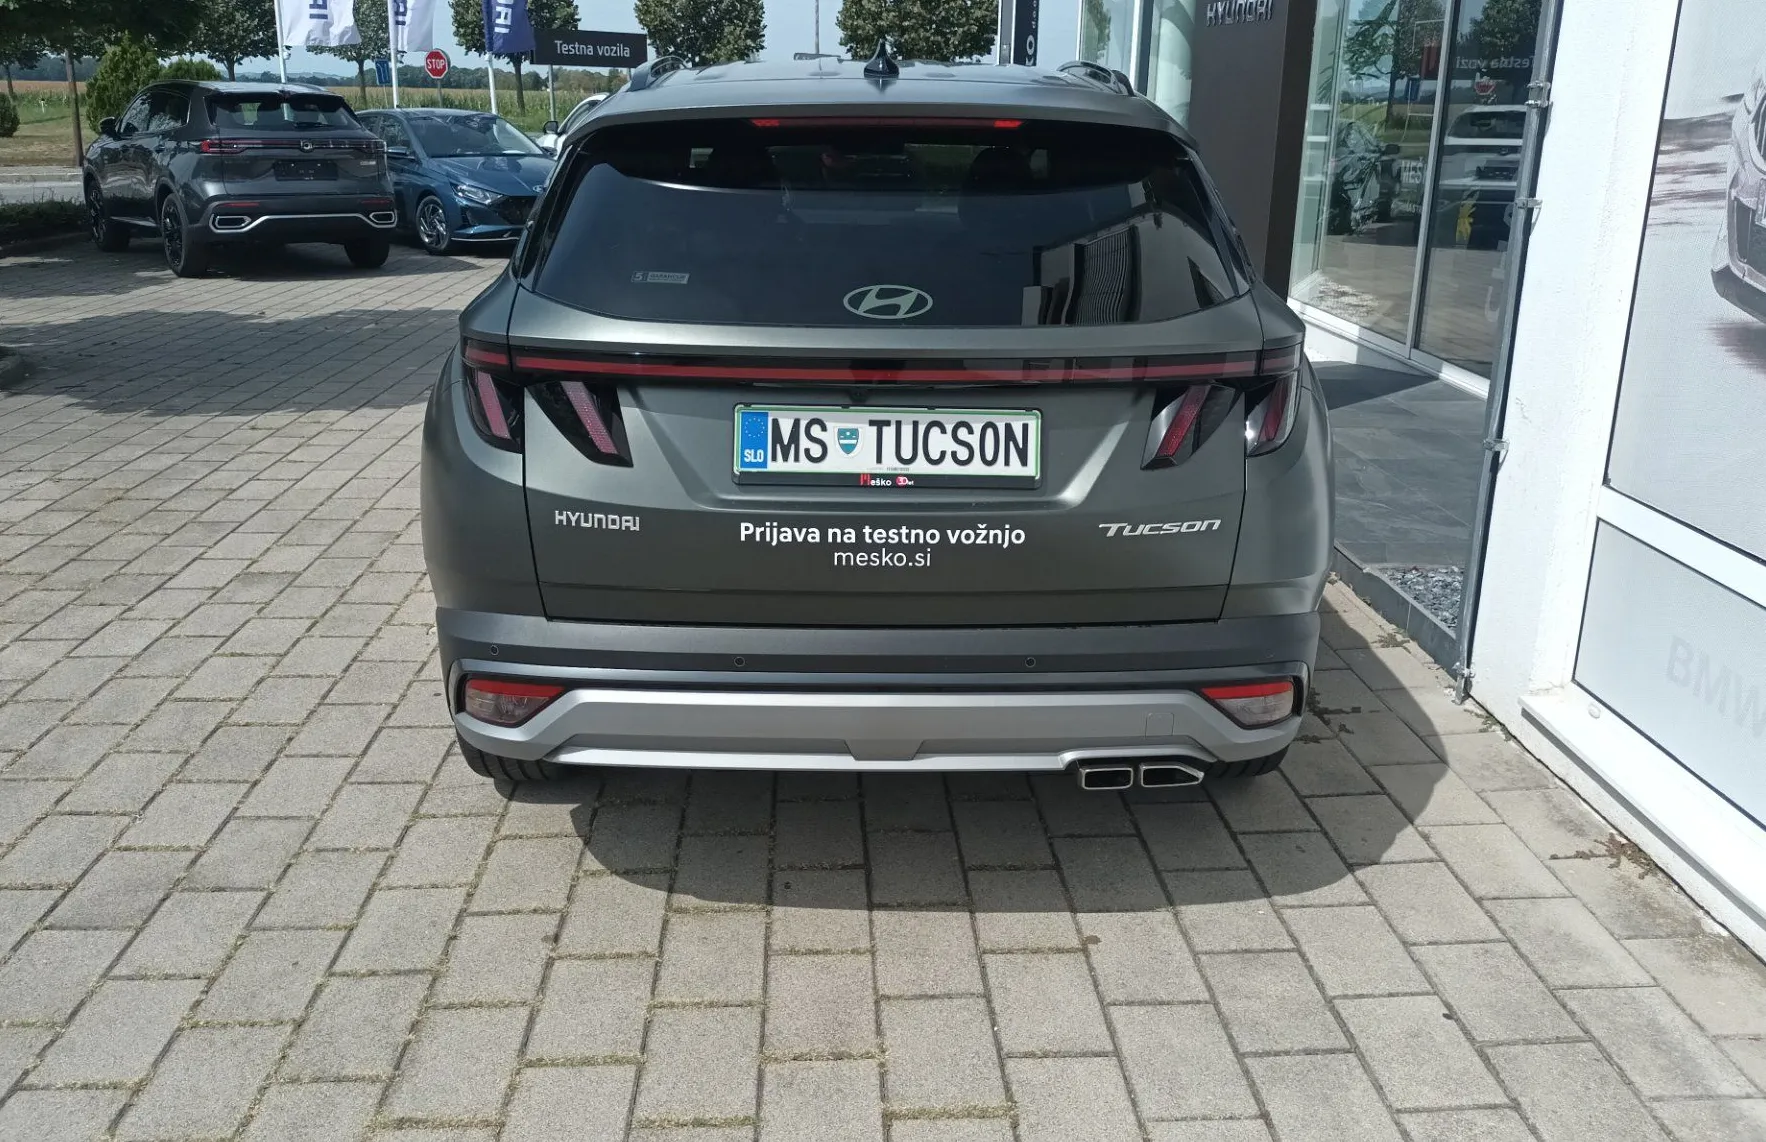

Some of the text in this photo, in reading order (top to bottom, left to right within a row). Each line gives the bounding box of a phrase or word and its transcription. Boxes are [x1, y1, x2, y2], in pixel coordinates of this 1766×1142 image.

[1206, 0, 1273, 27] HYUNDAI
[554, 40, 630, 57] Testna vozila
[427, 58, 445, 69] STOP
[771, 417, 1029, 467] MS TUCSON
[744, 448, 763, 463] SLO
[555, 510, 640, 531] HYUNDAI
[740, 522, 1026, 549] Prijava na testno vožnjo
[834, 548, 931, 567] mesko.si
